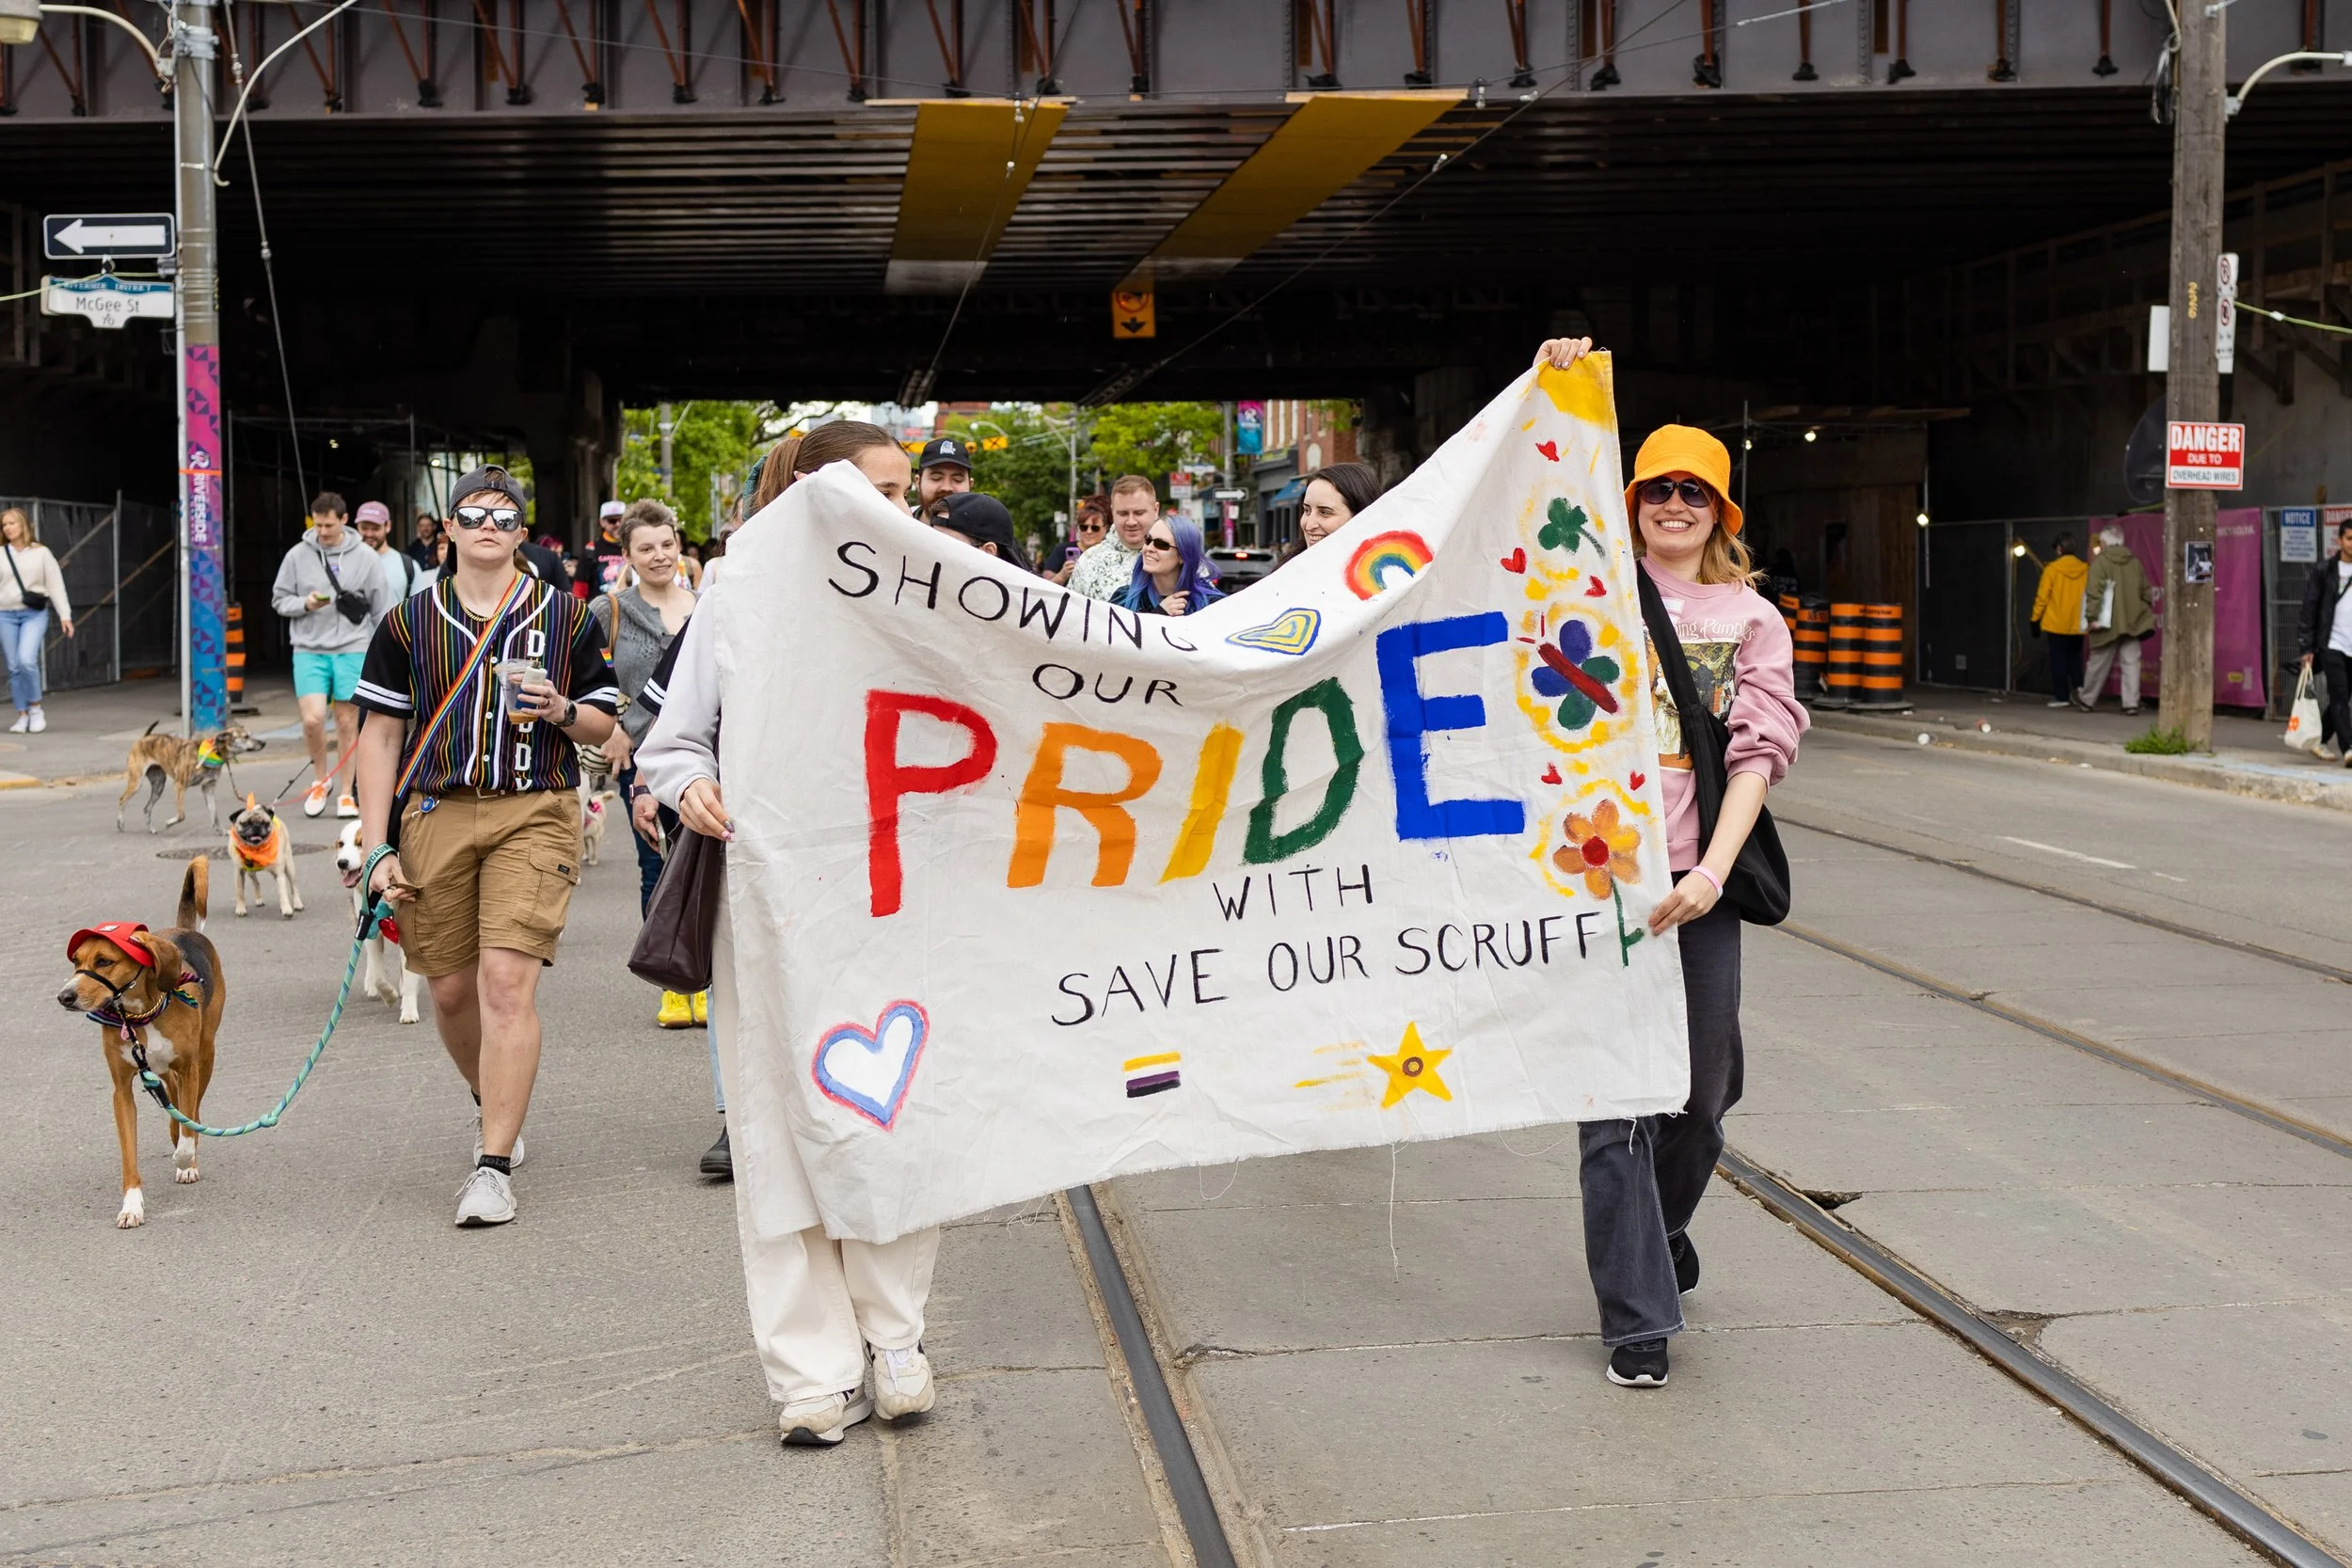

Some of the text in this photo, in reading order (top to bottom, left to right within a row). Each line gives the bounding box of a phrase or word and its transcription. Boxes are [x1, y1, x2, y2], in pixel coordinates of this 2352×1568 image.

[76, 297, 140, 313] McGee St
[2171, 425, 2241, 452] DANGER
[2173, 469, 2237, 482] OVERHEAD WIRES
[2187, 452, 2223, 465] DUE TO
[193, 472, 207, 543] RIVERSIDE
[2285, 511, 2311, 525] NOTICE
[1032, 663, 1184, 707] OUR
[863, 611, 1526, 918] PRIDE
[1214, 863, 1373, 922] WITH
[1051, 911, 1604, 1026] SAVE OUR SCRUFF
